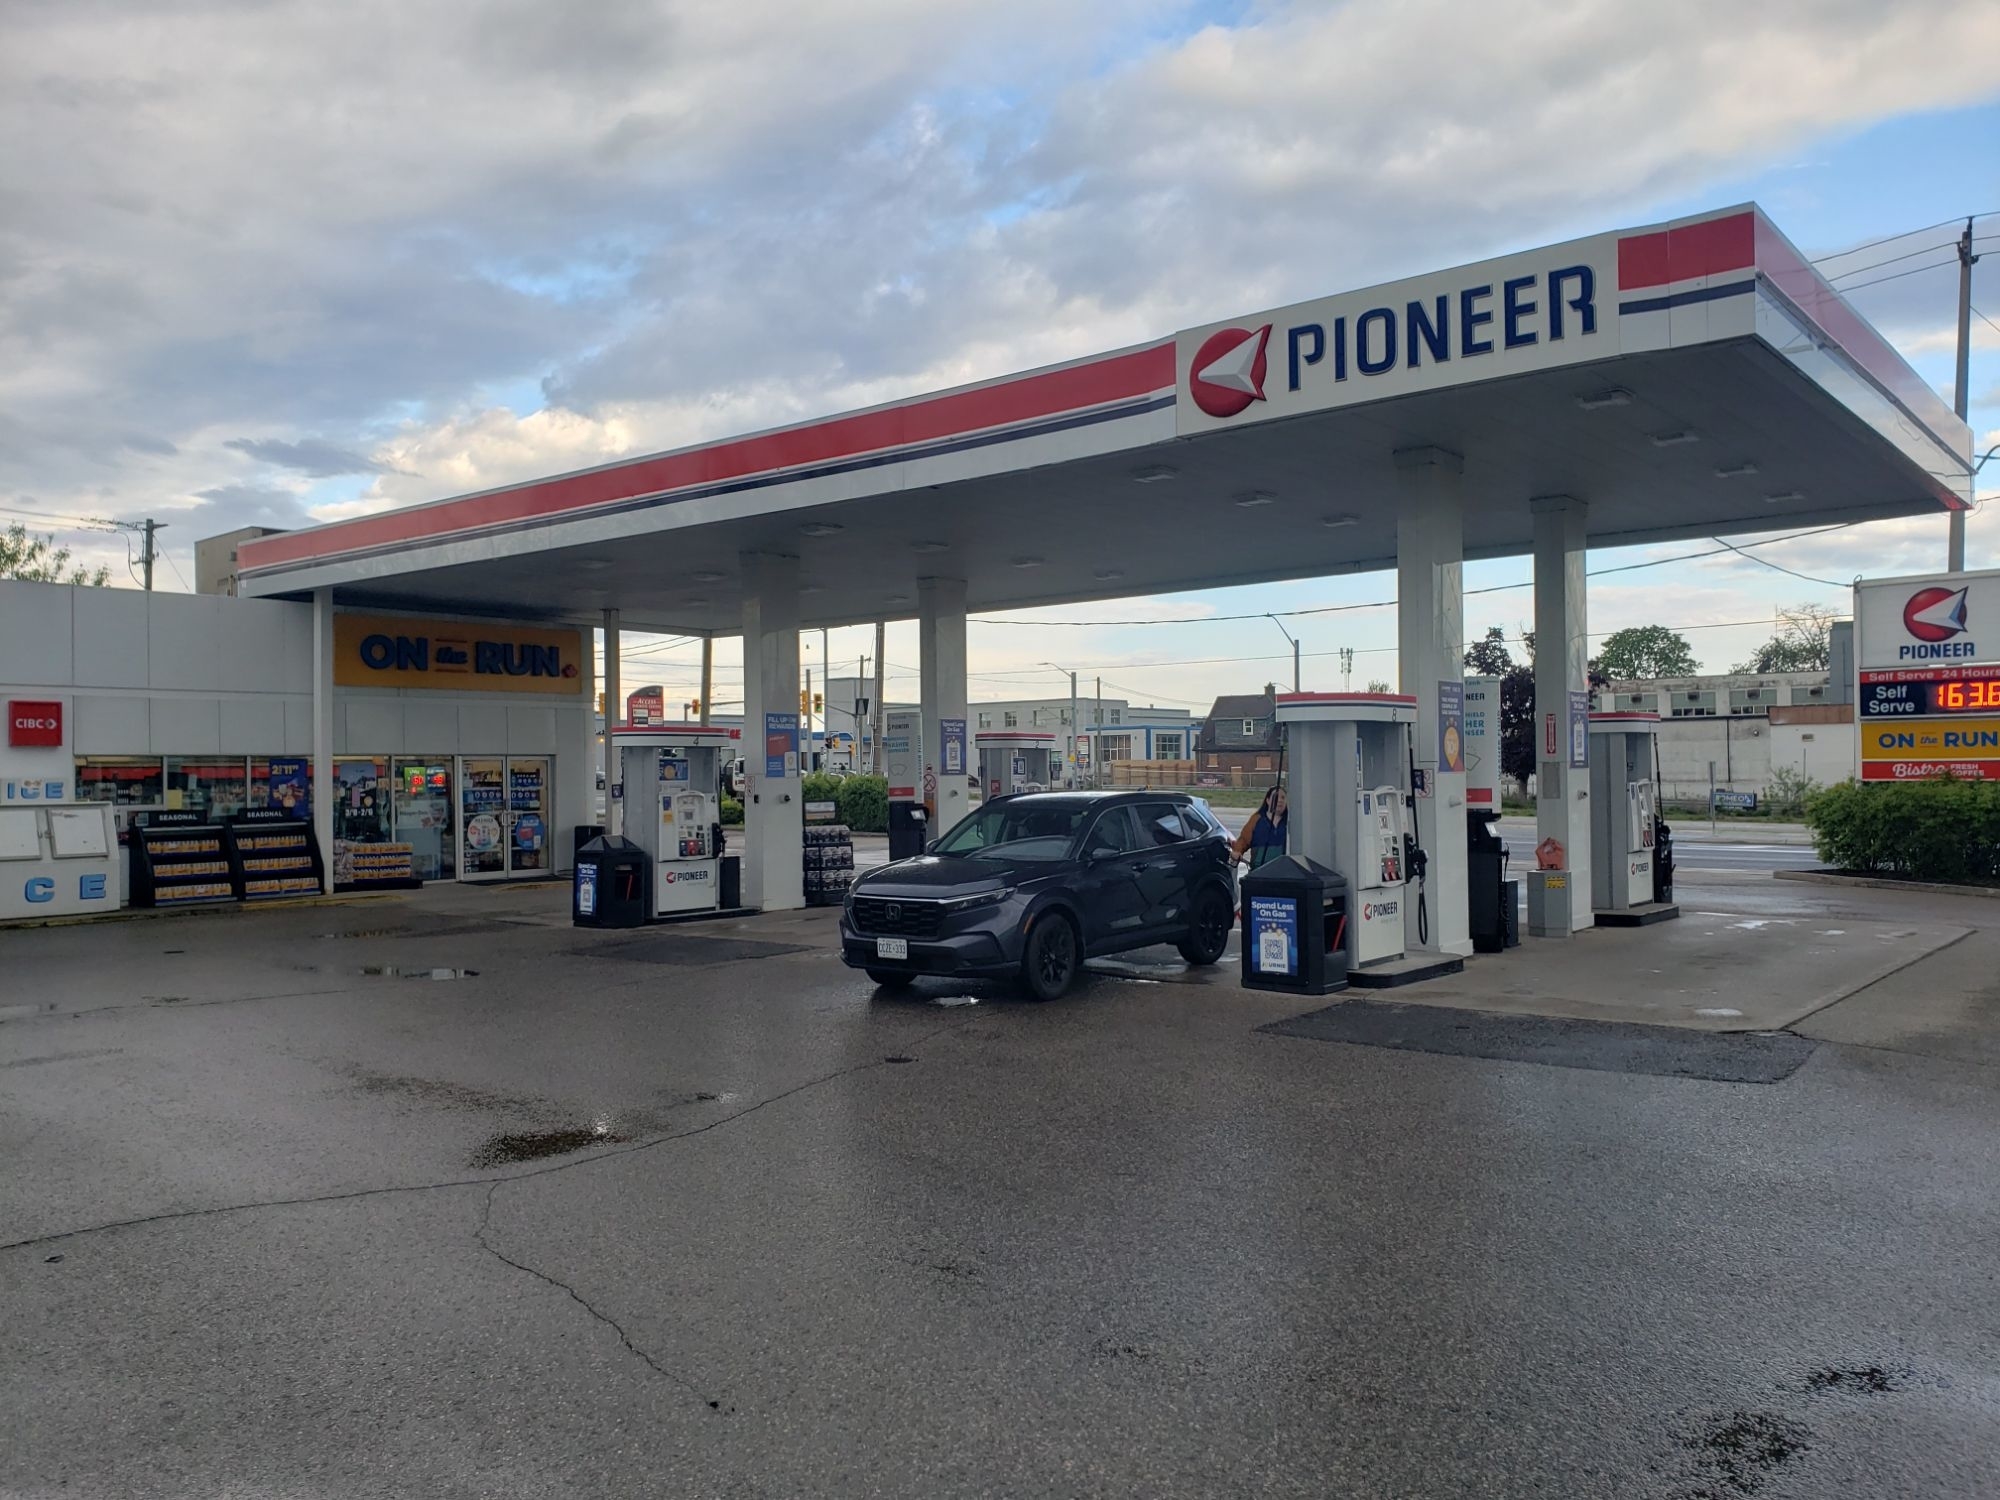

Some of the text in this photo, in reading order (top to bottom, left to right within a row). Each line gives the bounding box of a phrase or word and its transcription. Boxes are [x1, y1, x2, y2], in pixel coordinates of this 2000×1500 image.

[1287, 264, 1598, 392] PIONEER
[360, 634, 560, 678] ON the RUN
[1899, 642, 1975, 660] PIONEER
[1868, 672, 1893, 682] Self
[1897, 671, 1934, 681] Serve
[1942, 669, 1958, 679] 24
[1465, 692, 1485, 701] NEER
[1876, 685, 1908, 699] Self
[1869, 700, 1915, 713] Serve
[1391, 708, 1397, 721] 8
[15, 718, 45, 729] CIBC
[1465, 719, 1485, 728] HER
[1878, 731, 1998, 749] ON the RUN
[1892, 762, 1946, 778] Bistro
[7, 782, 64, 800] ICE
[159, 813, 198, 821] SEASONAL
[247, 810, 283, 818] SEASONAL
[677, 871, 708, 882] PIONEER
[1251, 901, 1294, 911] Spend Less
[1373, 901, 1398, 917] PIONEER
[1259, 909, 1287, 918] On Gas
